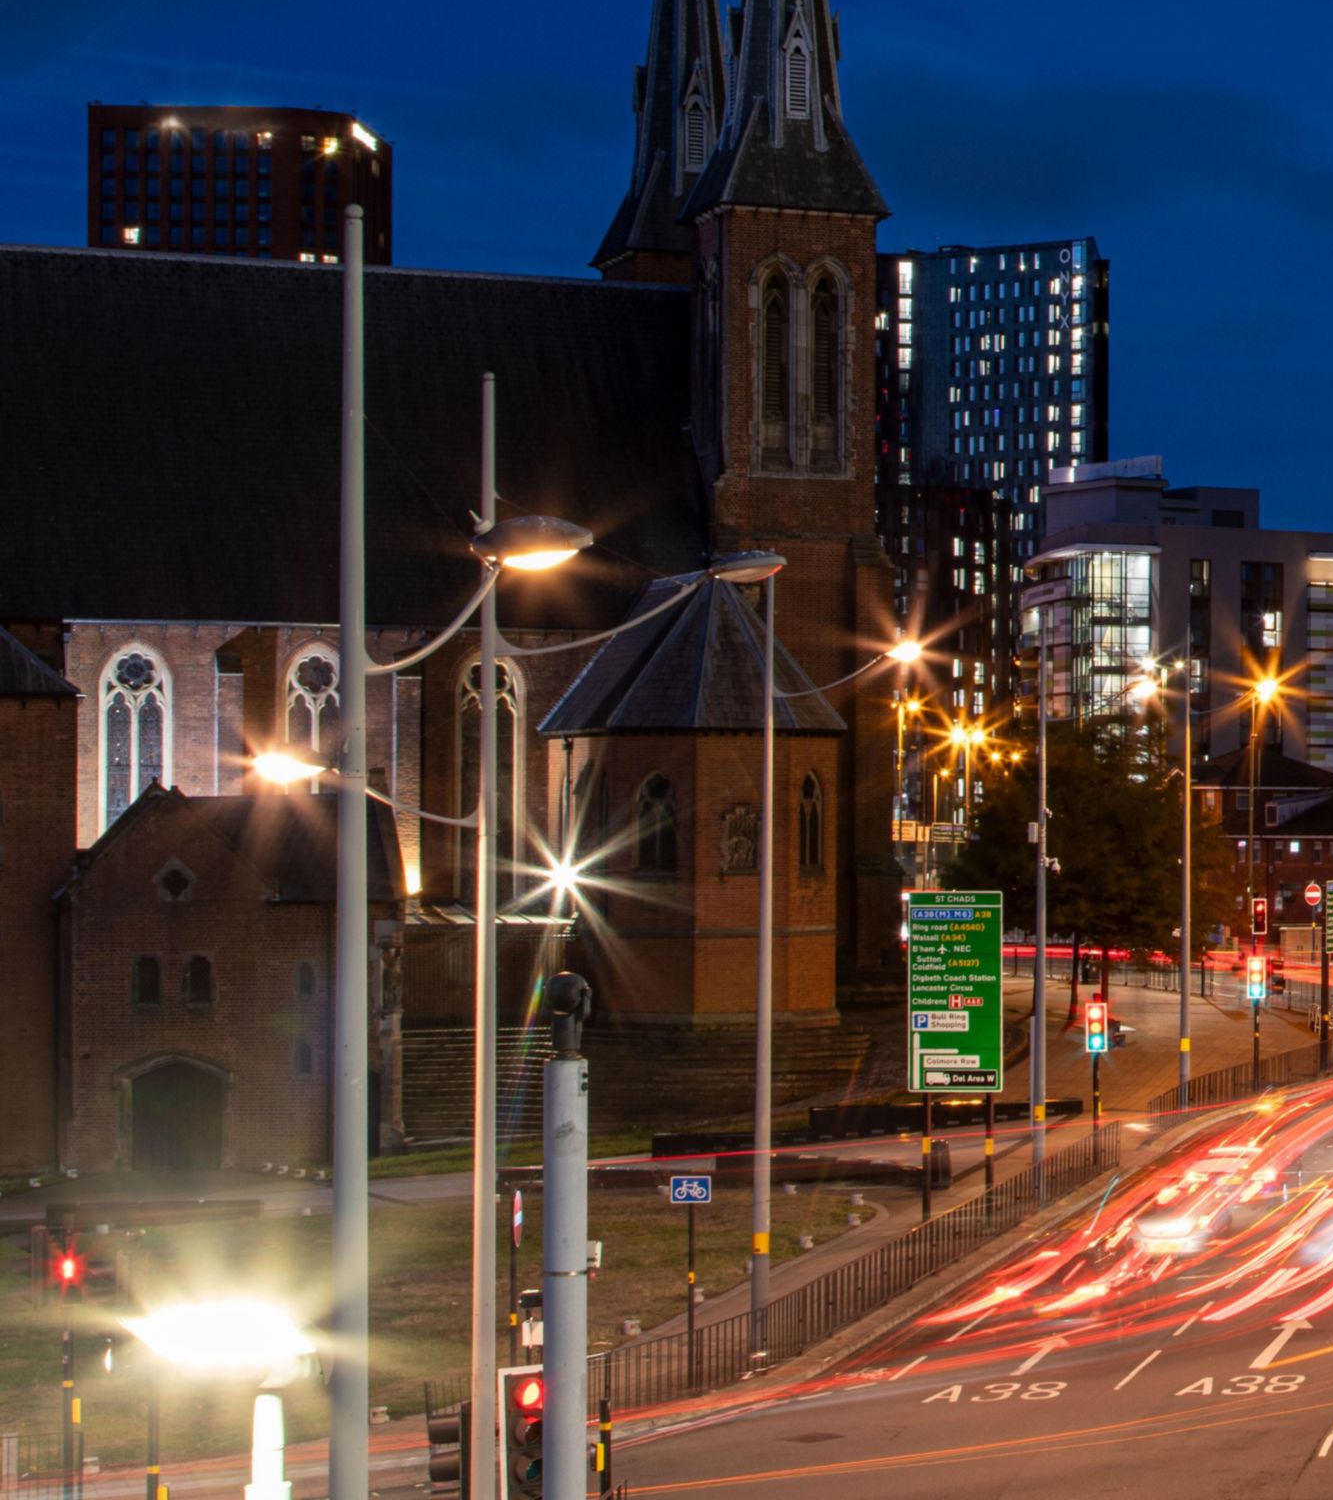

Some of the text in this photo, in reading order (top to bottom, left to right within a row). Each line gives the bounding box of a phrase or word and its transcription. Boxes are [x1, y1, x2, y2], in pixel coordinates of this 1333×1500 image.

[1059, 248, 1071, 329] ONYX
[935, 895, 976, 903] ST CHADS
[975, 911, 992, 919] A38
[912, 924, 929, 932] Ring
[950, 923, 985, 931] (A4540)
[940, 933, 967, 942] (A34)
[912, 945, 935, 953] B'ham
[916, 955, 980, 967] Sutton (A5127)
[912, 963, 946, 971] Coldfield
[912, 974, 942, 983] Digbeth
[912, 997, 947, 1005] Childrens
[949, 1013, 967, 1022] Ring
[931, 1022, 967, 1030] Shopping
[1174, 1374, 1306, 1397] A38
[921, 1381, 1068, 1403] A38
